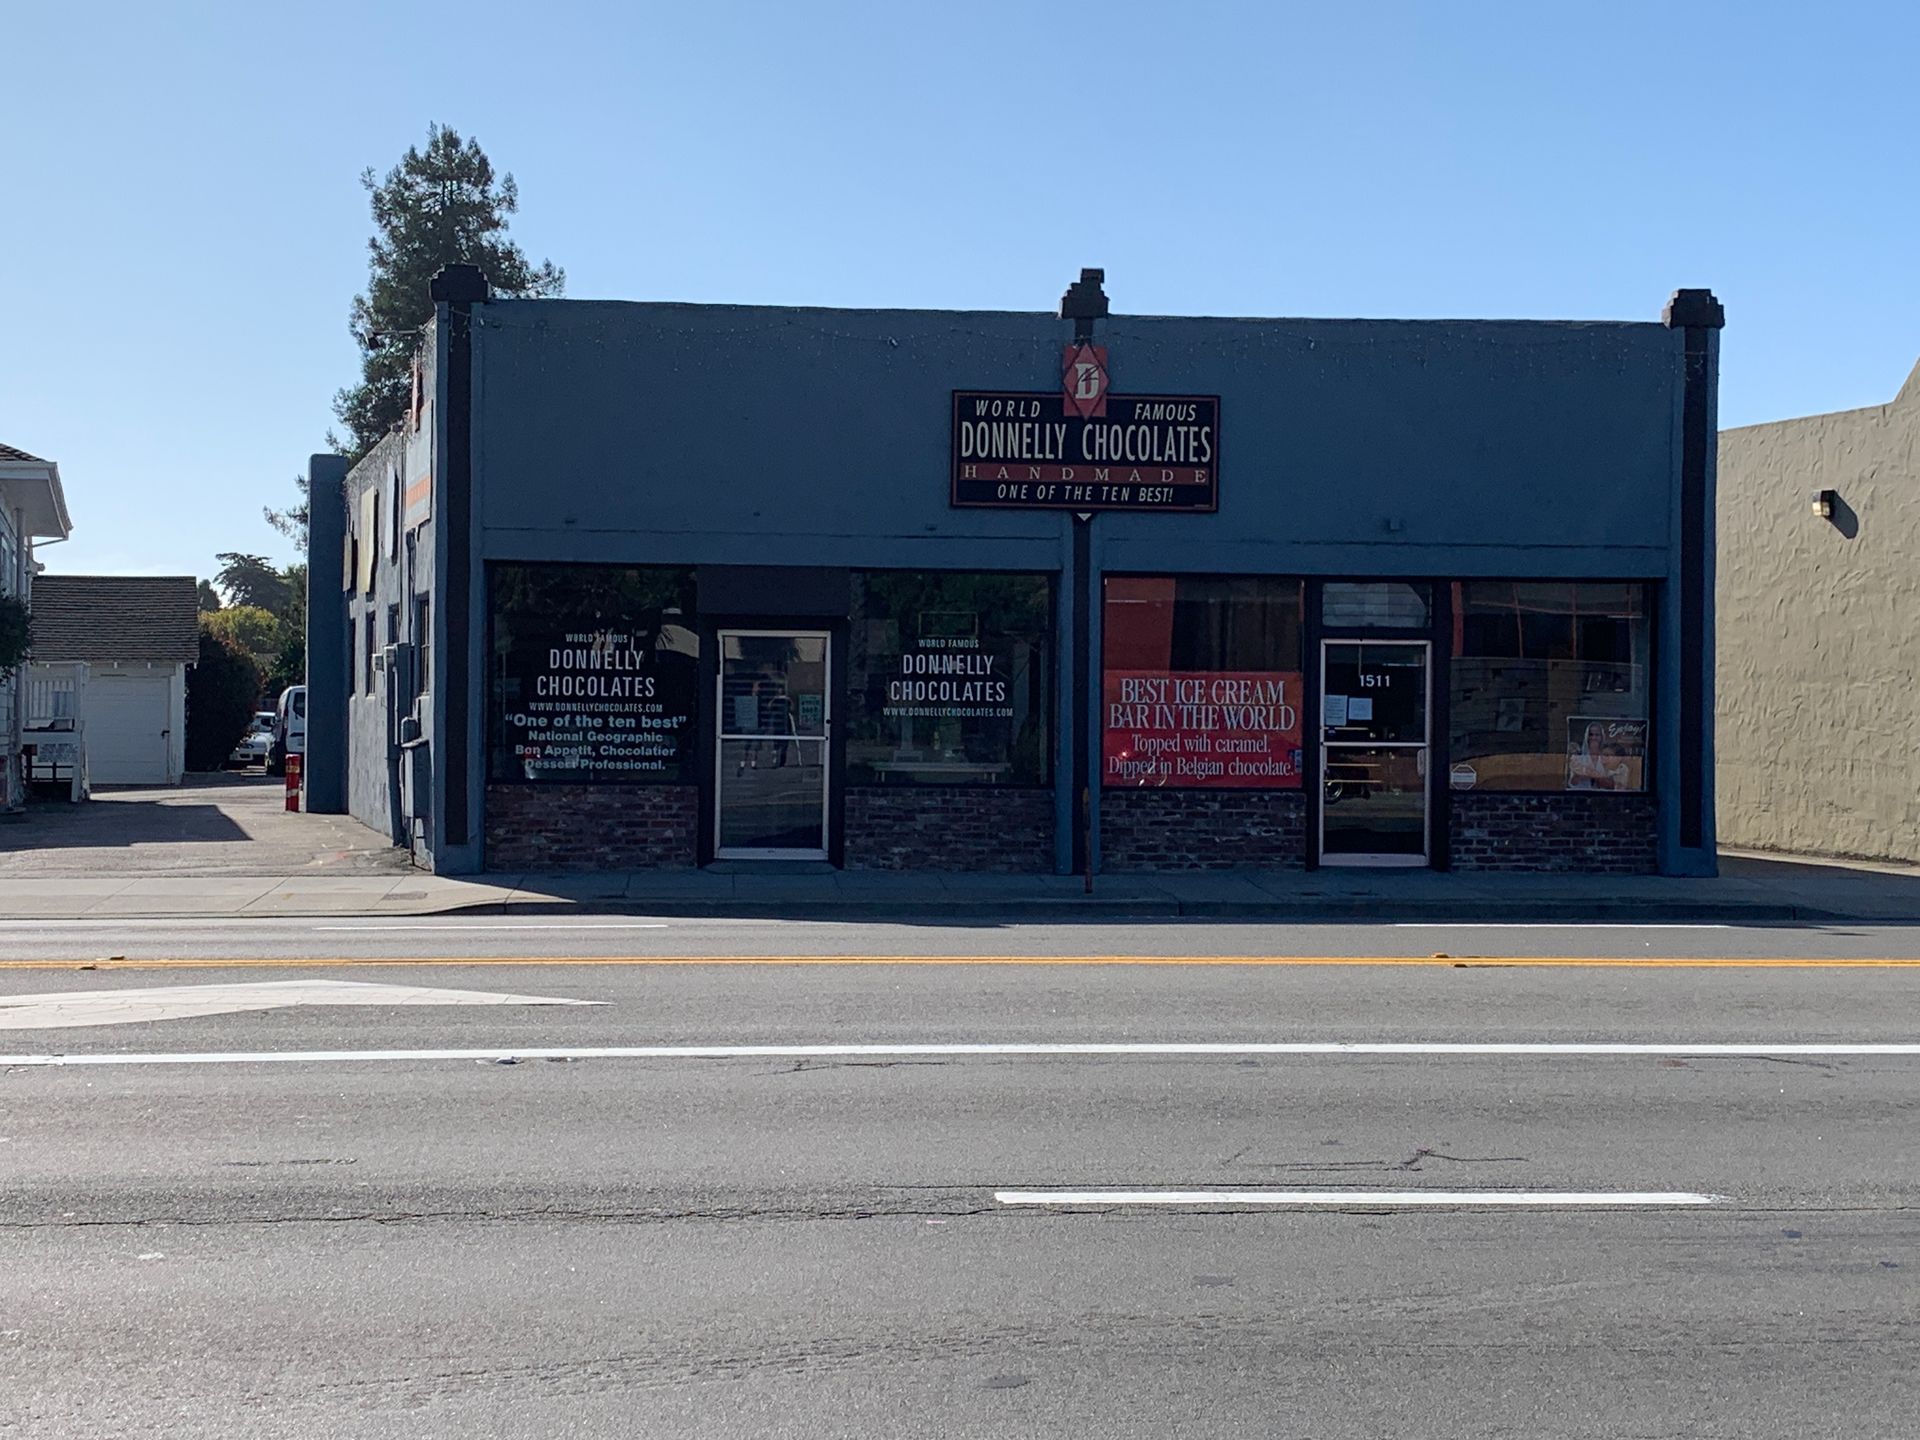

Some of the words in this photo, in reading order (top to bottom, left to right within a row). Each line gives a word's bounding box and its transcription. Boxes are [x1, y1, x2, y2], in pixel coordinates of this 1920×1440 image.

[976, 399, 1041, 418] WORLD
[1135, 403, 1197, 421] FAMOUS
[961, 421, 1067, 460] DONNELLY
[1082, 423, 1211, 463] CHOCOLATES
[964, 465, 1206, 483] HANDMADE
[998, 484, 1028, 500] ONE
[1037, 485, 1056, 500] OF
[1065, 486, 1092, 500] THE
[1102, 486, 1130, 501] TEN
[1139, 487, 1174, 502] BEST!
[566, 633, 593, 643] WORLD
[918, 639, 946, 648] WORLD
[948, 639, 980, 648] FAMOUS
[550, 649, 644, 670] DONNELLY
[903, 654, 994, 675] DONNELLY
[537, 675, 655, 697] CHOCOLATES
[1360, 674, 1390, 687] 1511
[890, 681, 1006, 702] CHOCOLATES
[1121, 678, 1169, 703] BEST
[1175, 679, 1206, 704] ICE
[1211, 679, 1285, 705] CREAM
[529, 702, 663, 712] WWW.DONNELLYCHOCOLATES.COM
[883, 707, 1013, 717] WWW.DONNELLYCHOCOLATES.COM
[553, 714, 570, 727] of
[575, 714, 603, 728] the
[608, 715, 636, 728] ten
[1109, 704, 1149, 729] BAR
[1155, 704, 1177, 729] IN
[1179, 704, 1219, 730] THE
[1222, 705, 1295, 731] WORLD
[528, 730, 583, 741] National
[587, 731, 664, 744] Geographic
[1132, 733, 1180, 756] Topped
[1184, 734, 1211, 752] with
[1215, 734, 1271, 753] caramel.
[515, 744, 541, 755] Bon
[600, 745, 676, 756] Chocolatier
[580, 758, 666, 770] Professional.
[1109, 756, 1156, 779] Dipped
[1160, 757, 1172, 774] in
[1177, 757, 1224, 779] Belgian
[1228, 757, 1294, 776] chocolate.
